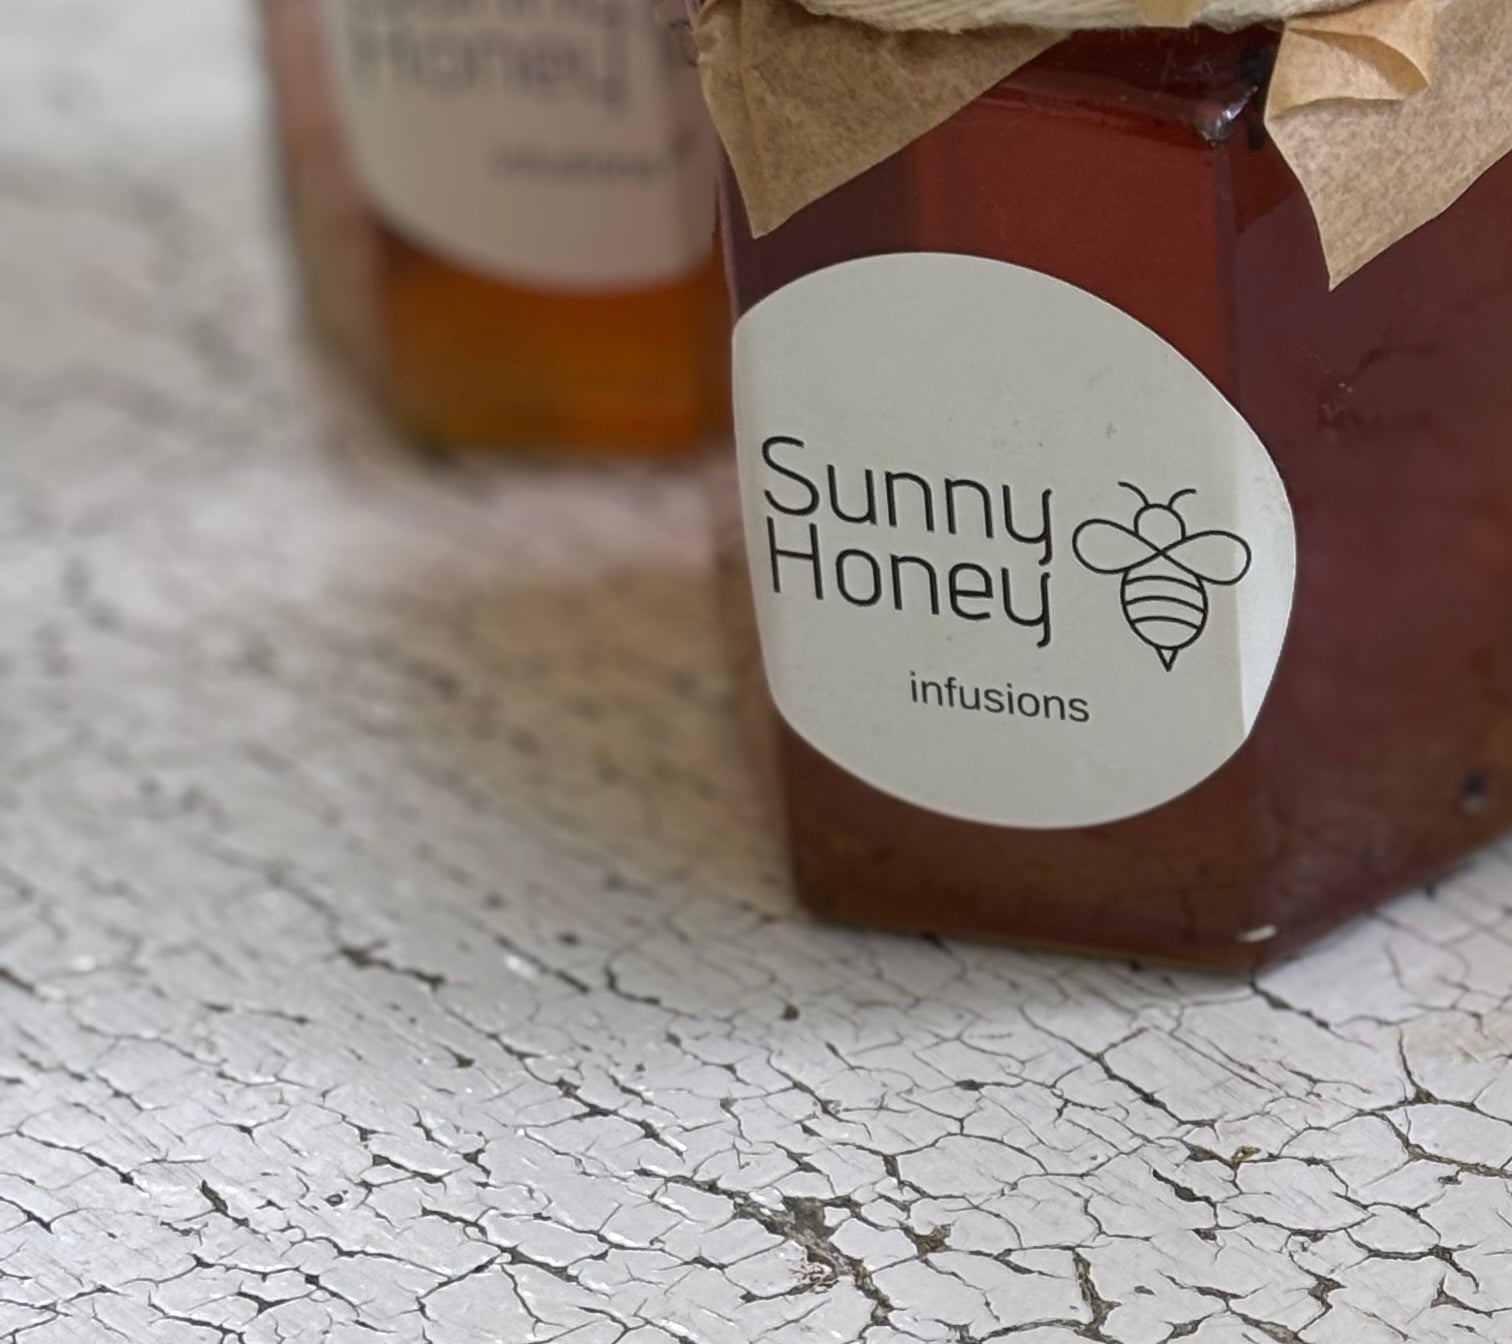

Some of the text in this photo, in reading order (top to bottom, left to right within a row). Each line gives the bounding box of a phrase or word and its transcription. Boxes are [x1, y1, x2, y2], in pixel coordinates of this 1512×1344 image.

[761, 434, 1053, 567] Sunny
[766, 515, 1052, 649] Honey
[909, 670, 1091, 724] infusions
